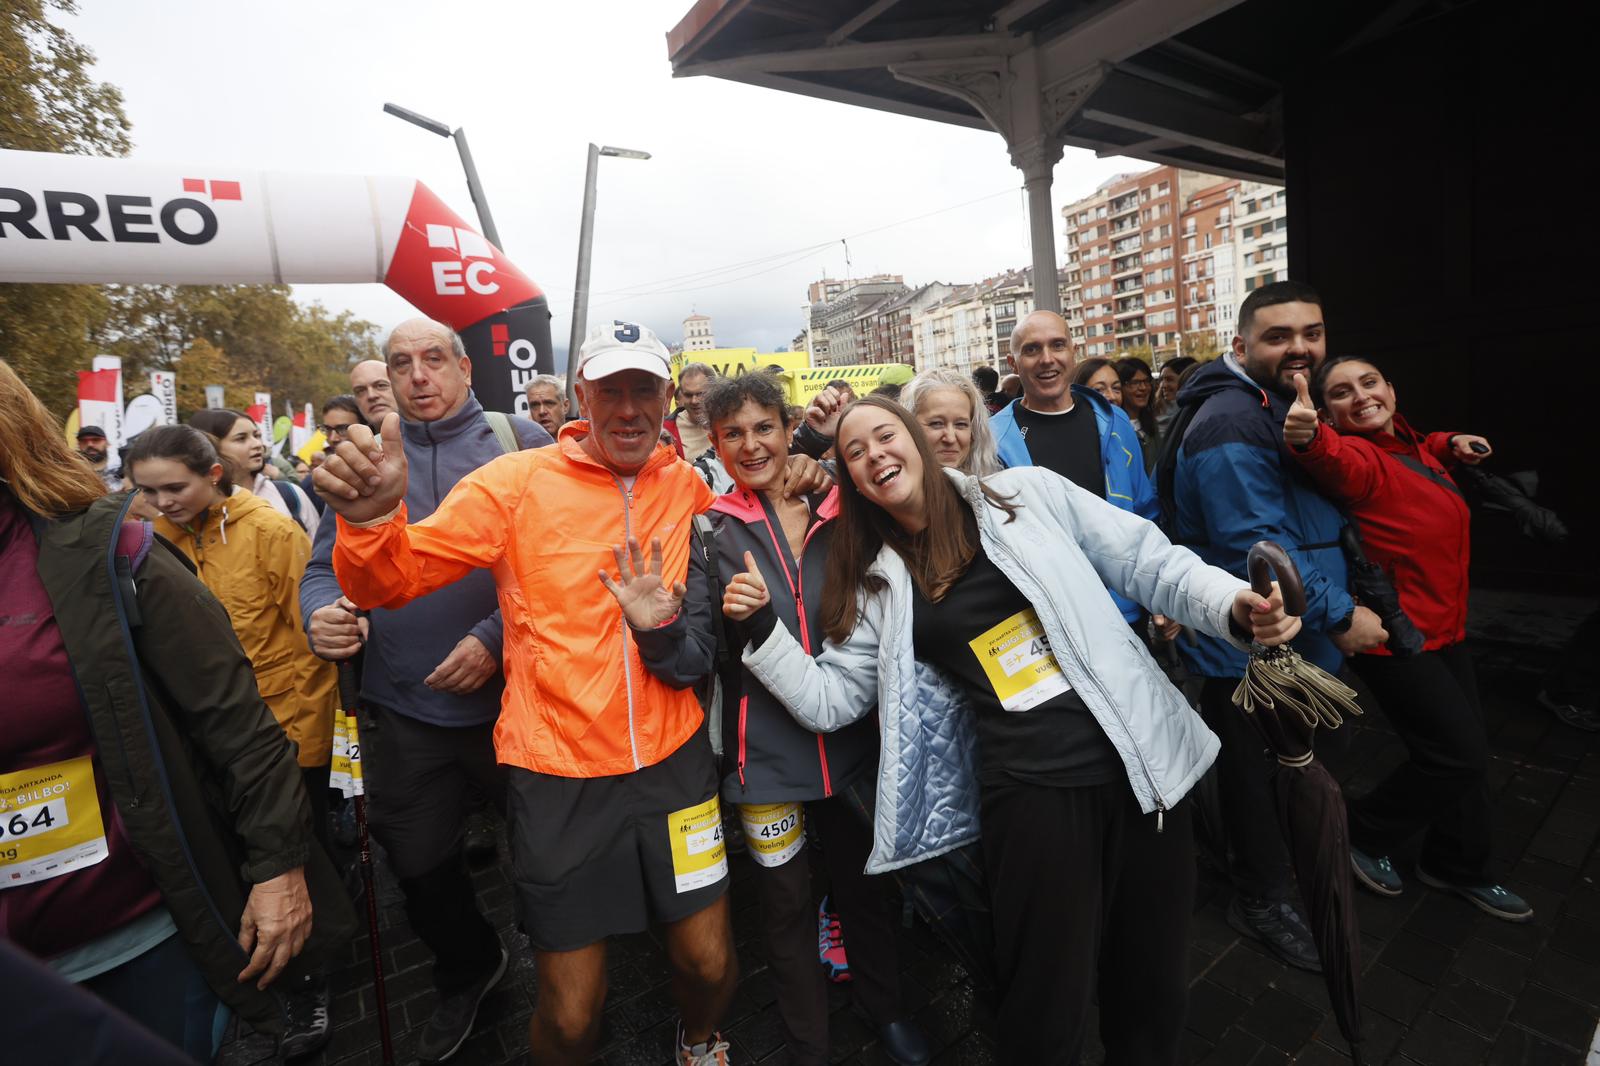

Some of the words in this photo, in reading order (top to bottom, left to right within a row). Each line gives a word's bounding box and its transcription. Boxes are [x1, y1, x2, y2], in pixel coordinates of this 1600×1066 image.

[431, 261, 500, 296] EC
[17, 781, 71, 805] BILBO!
[19, 773, 63, 791] ARTXANDA
[0, 805, 55, 838] 64
[760, 814, 796, 839] 4502
